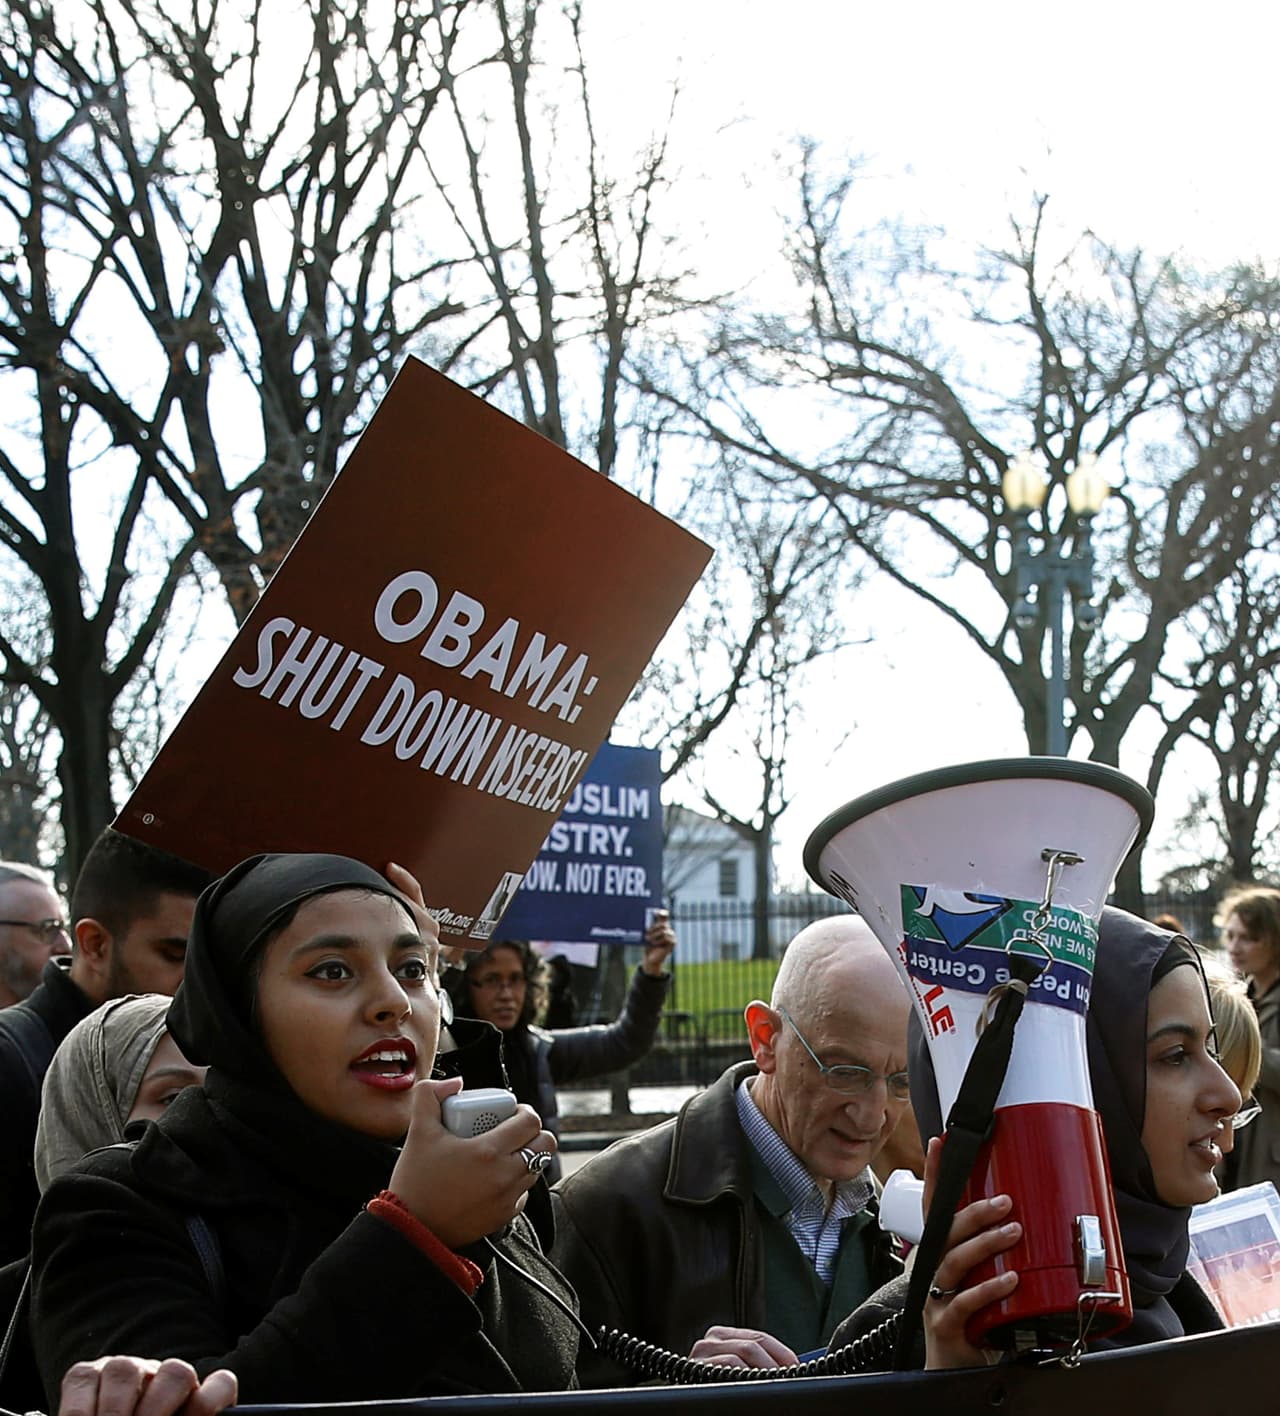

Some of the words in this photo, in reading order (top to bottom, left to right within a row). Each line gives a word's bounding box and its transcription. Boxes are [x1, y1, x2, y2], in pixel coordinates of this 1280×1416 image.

[374, 570, 599, 724] OBAMA:
[232, 617, 385, 731] SHUT
[360, 673, 500, 786] DOWN
[478, 725, 589, 813] NSEERS!
[566, 863, 602, 895] NOT
[604, 865, 651, 897] EVER.
[1066, 938, 1086, 957] WE
[909, 951, 986, 985] Center
[995, 966, 1071, 1001] Peae
